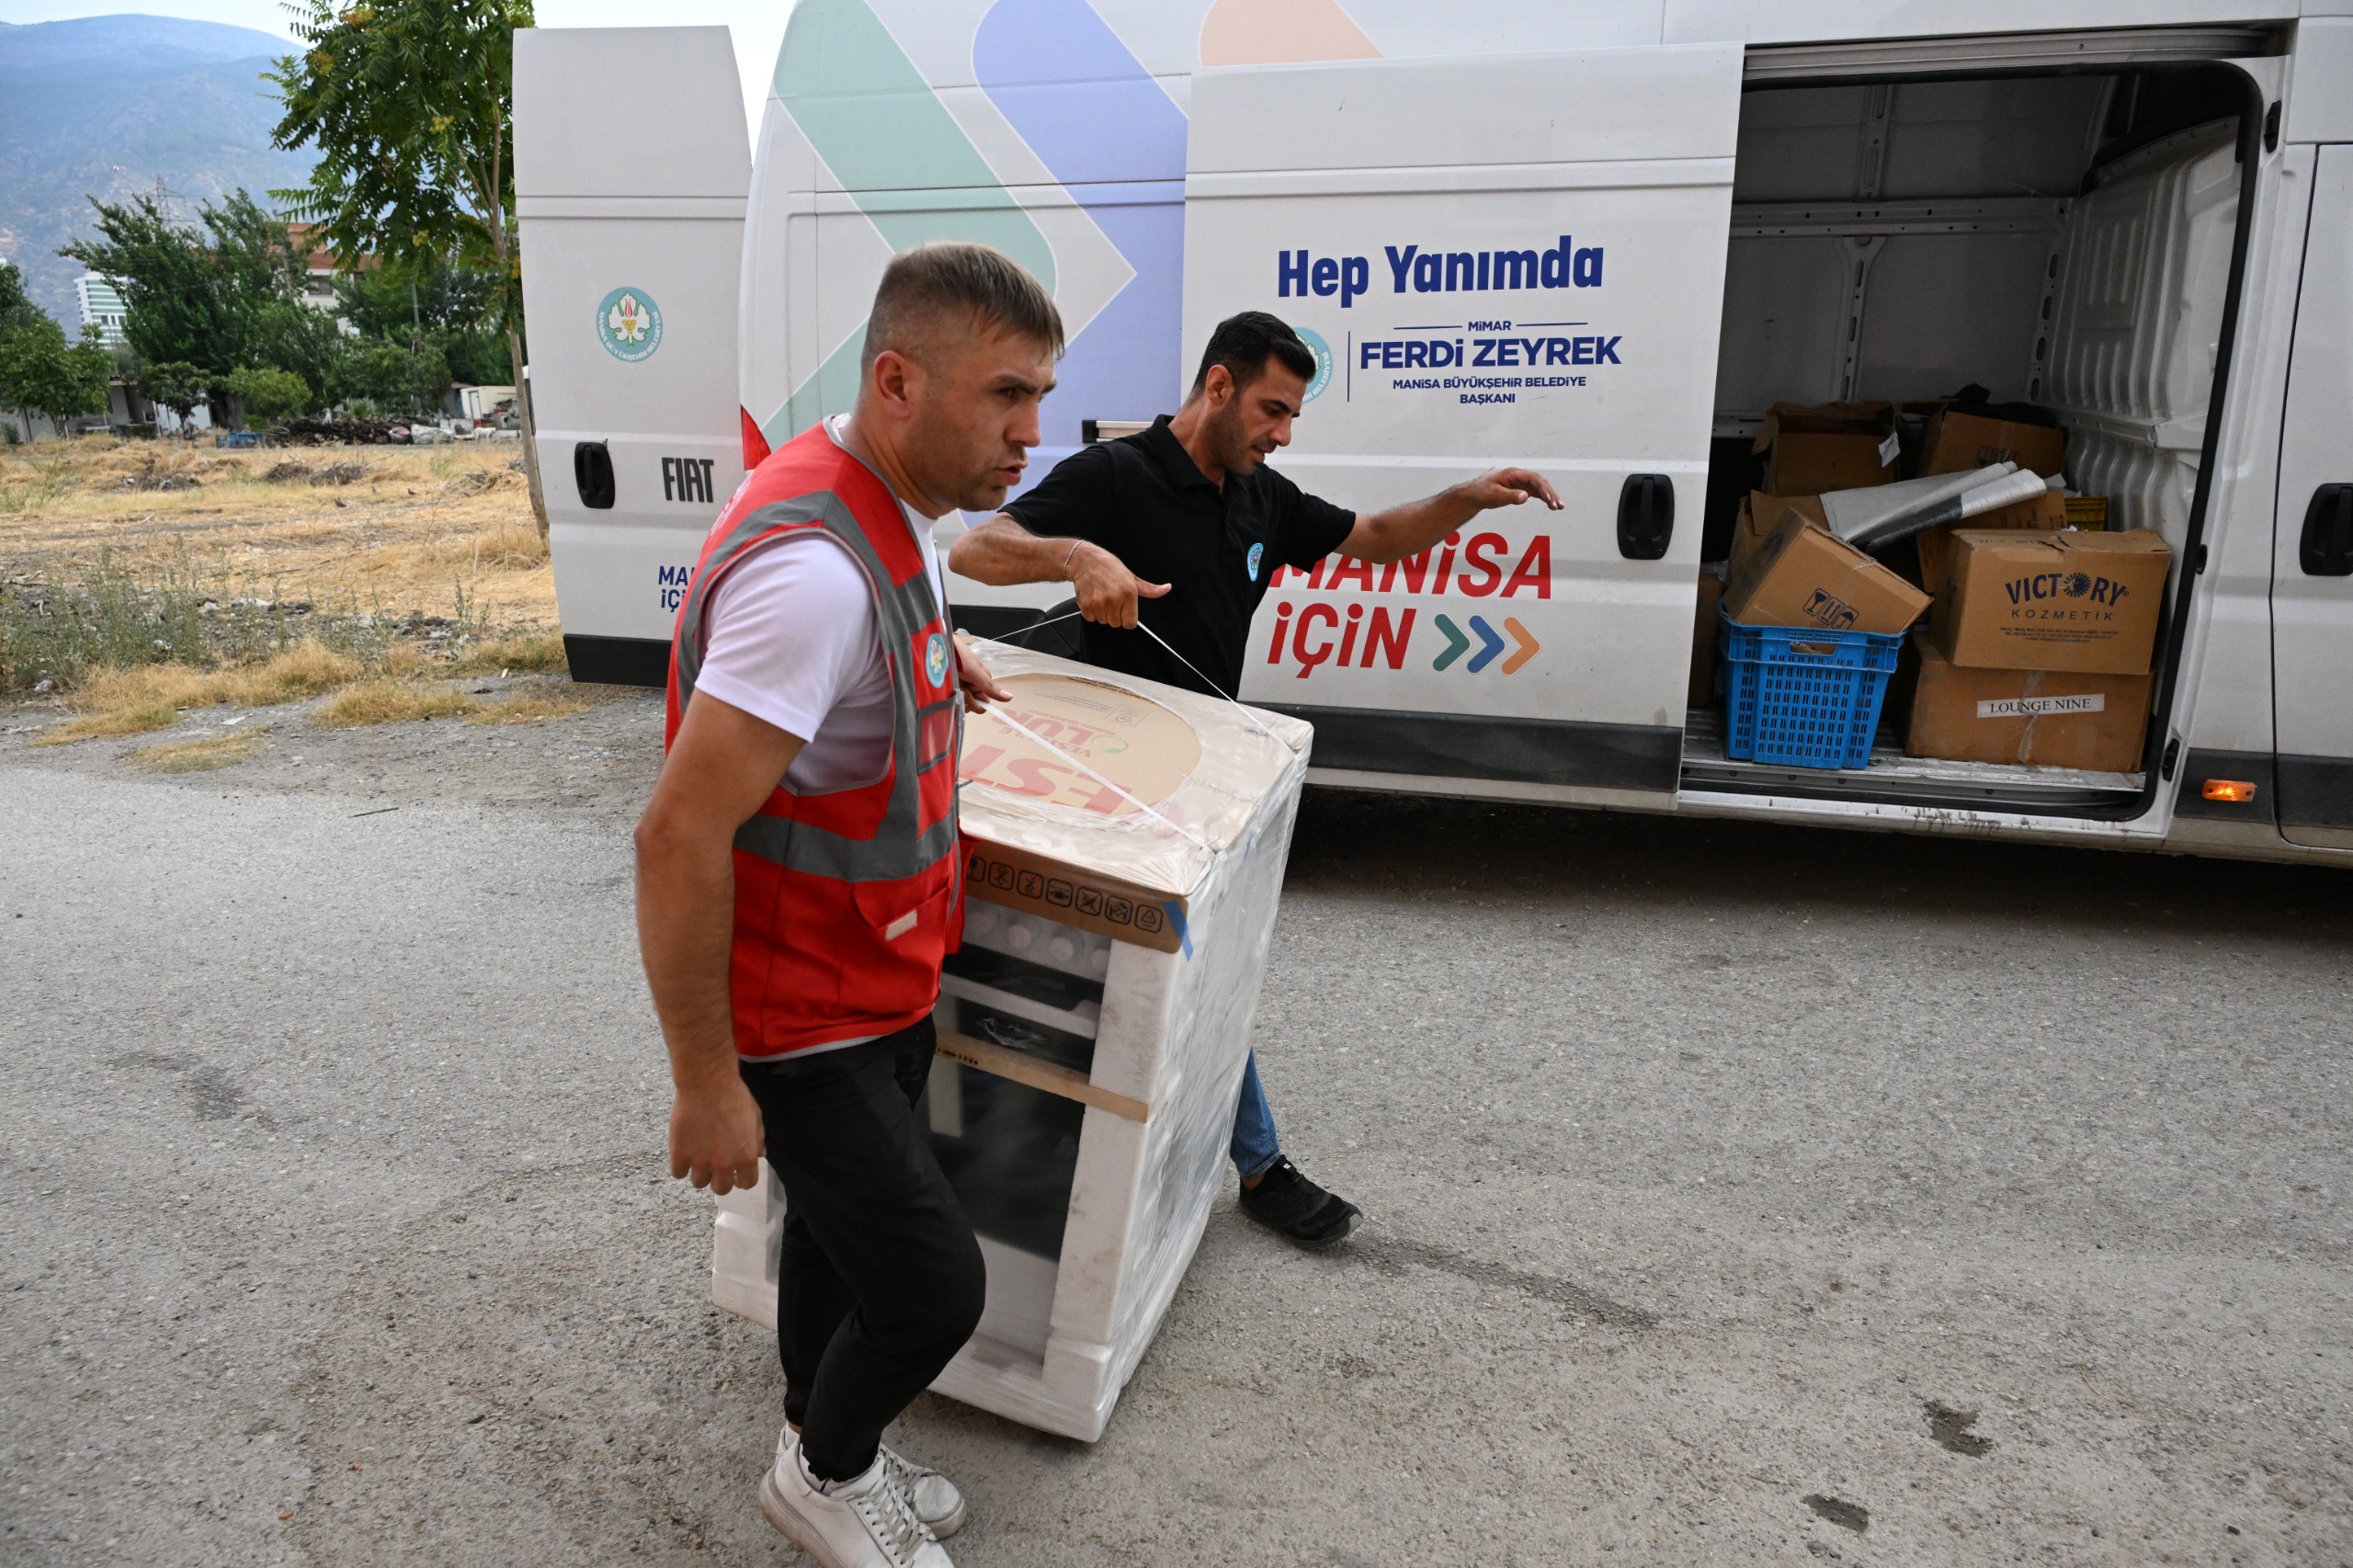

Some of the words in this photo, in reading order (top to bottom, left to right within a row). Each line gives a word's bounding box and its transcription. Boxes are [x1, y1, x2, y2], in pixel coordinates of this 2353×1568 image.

[1279, 249, 1370, 309] Hep
[1384, 235, 1604, 293] Yanımda
[1468, 321, 1512, 331] MİMAR
[1360, 338, 1464, 369] FERDİ
[1472, 336, 1622, 367] ZEYREK
[1392, 379, 1440, 390] MANİSA
[1443, 376, 1522, 390] BÜYÜKŞEHİR
[1525, 376, 1587, 388] BELEDİYE
[1460, 393, 1516, 405] BAŞKANI
[662, 458, 714, 503] FIAT
[2011, 608, 2114, 621] KOZMETİK
[1267, 601, 1417, 679] İÇİN
[1990, 700, 2051, 713] LOUNGE
[2054, 698, 2092, 710] NINE
